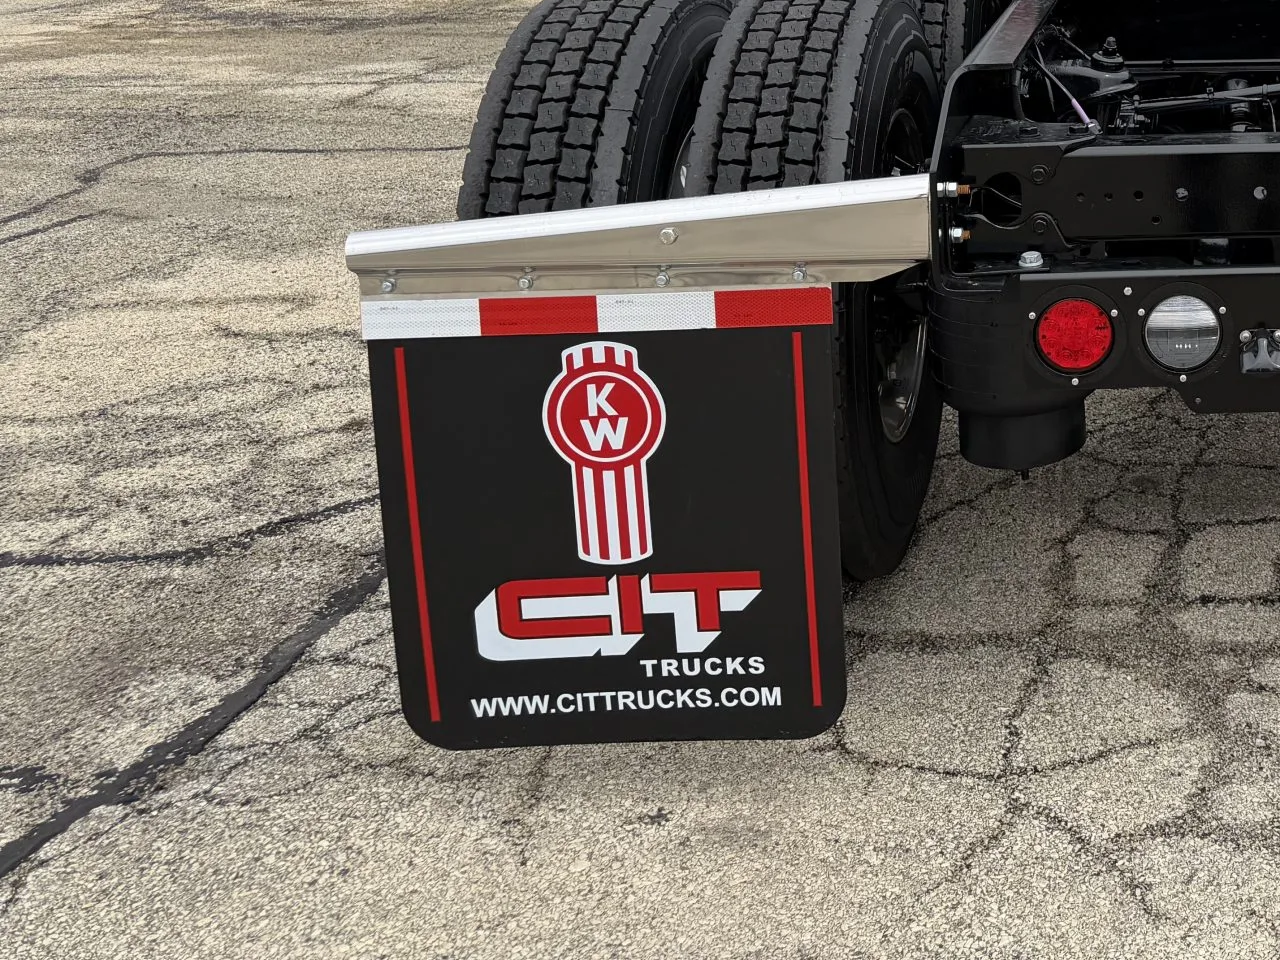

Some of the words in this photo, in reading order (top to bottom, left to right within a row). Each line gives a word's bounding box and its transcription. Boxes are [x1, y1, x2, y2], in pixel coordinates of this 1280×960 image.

[474, 571, 762, 662] CIT
[639, 656, 766, 678] TRUCKS
[470, 686, 782, 718] WWW.CITTRUCKS.COM
